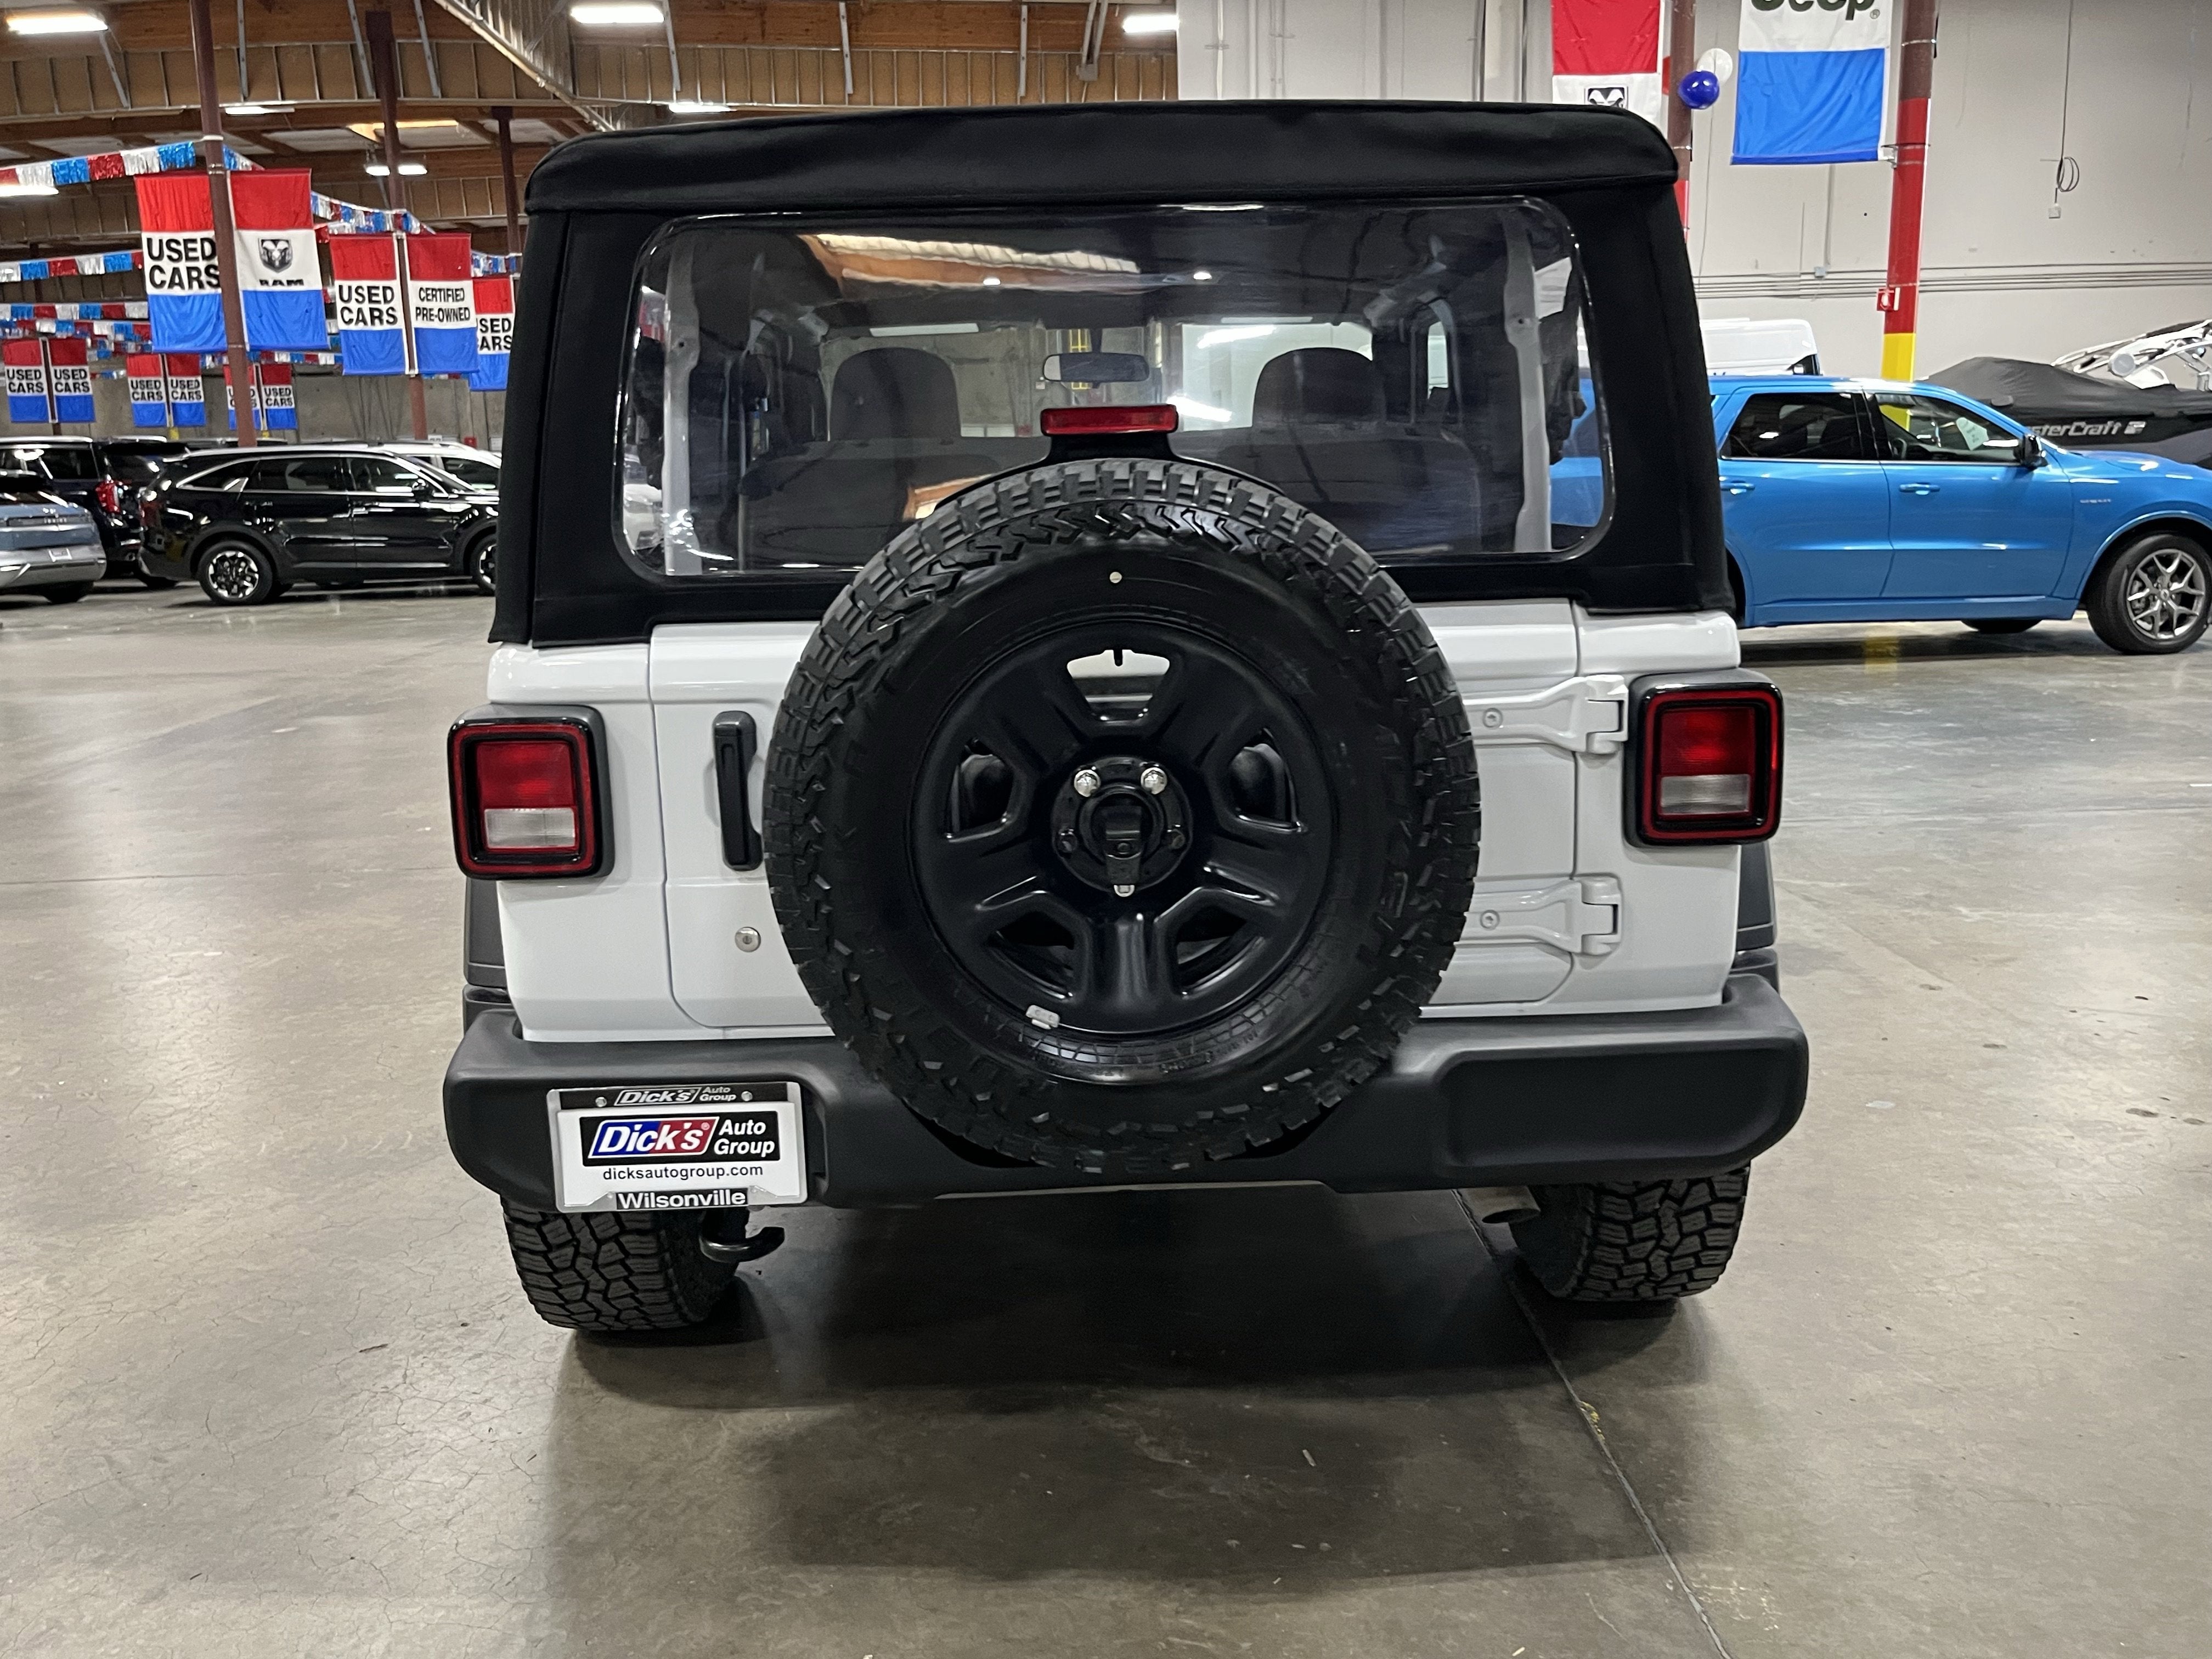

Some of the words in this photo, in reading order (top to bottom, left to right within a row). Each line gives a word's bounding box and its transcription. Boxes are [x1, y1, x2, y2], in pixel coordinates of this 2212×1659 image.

[146, 238, 217, 262] USED
[149, 264, 219, 290] CARS
[338, 285, 394, 304] USED
[419, 287, 465, 302] CERTIFIED
[340, 306, 398, 326] CARS
[415, 307, 470, 323] PRE-OWNED
[476, 318, 511, 334] SED
[478, 335, 511, 351] ARS
[7, 369, 42, 381] USED
[54, 368, 88, 380] USED
[8, 381, 44, 393] CARS
[54, 381, 90, 393] CARS
[131, 379, 161, 390] USED
[171, 379, 200, 390] USED
[264, 387, 291, 397] USED
[132, 391, 163, 401] CARS
[171, 390, 202, 401] CARS
[266, 397, 293, 408] CARS
[2030, 420, 2121, 436] sterCraft
[620, 1090, 691, 1103] Dick's
[699, 1093, 736, 1102] Group
[718, 1119, 766, 1136] Auto
[599, 1123, 702, 1153] Dick's
[714, 1138, 775, 1158] Group
[603, 1165, 763, 1181] dicksautogroup.com
[618, 1190, 746, 1209] Wilsonville
